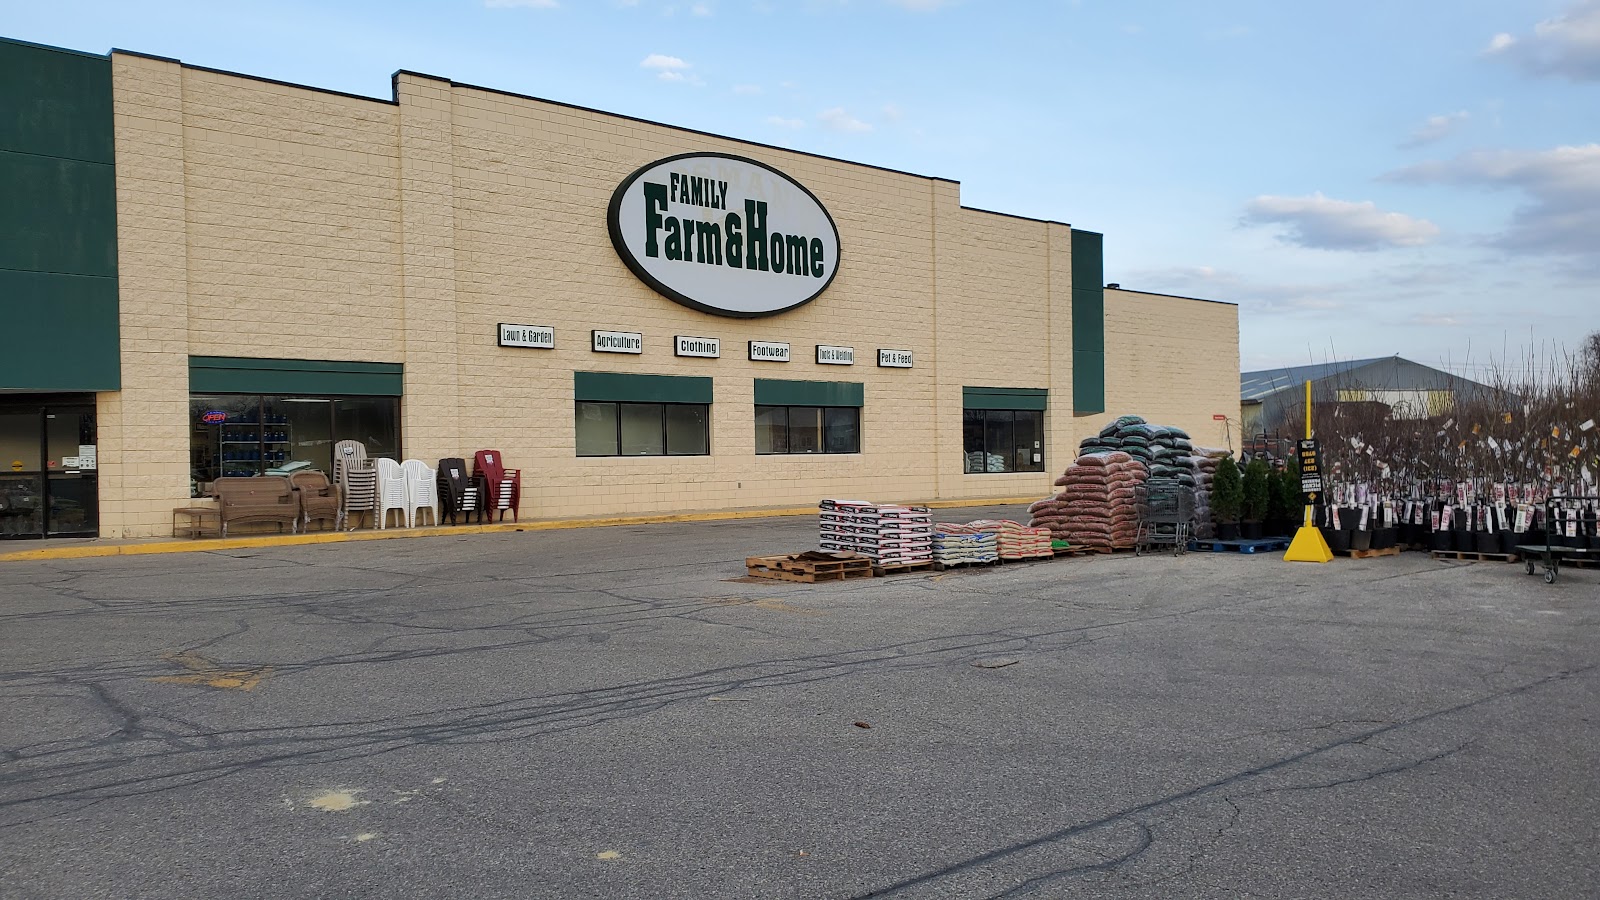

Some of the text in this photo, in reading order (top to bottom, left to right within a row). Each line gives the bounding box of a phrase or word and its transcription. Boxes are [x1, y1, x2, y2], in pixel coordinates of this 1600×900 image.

[670, 172, 728, 210] FAMILY
[503, 328, 552, 343] Lawn & Garden
[597, 334, 640, 349] Agriculture
[681, 340, 716, 354] Clothing
[753, 345, 789, 357] Footwear
[881, 352, 911, 363] Pet & Feed
[202, 413, 226, 422] OPEN
